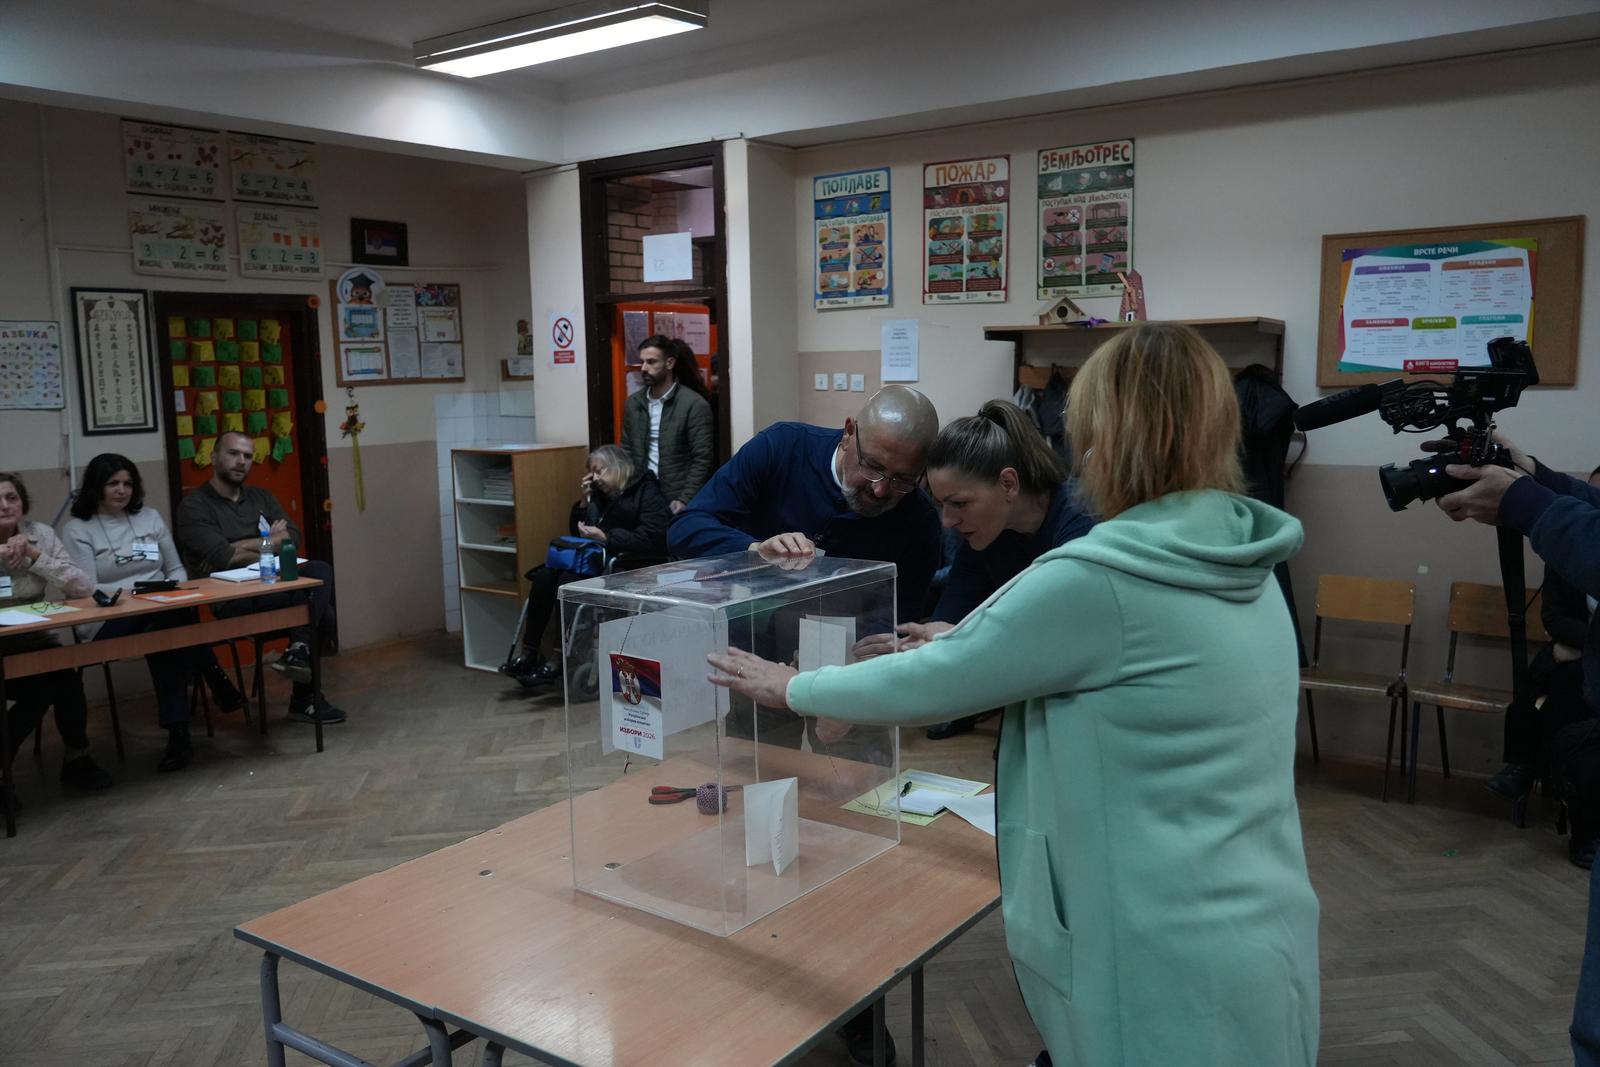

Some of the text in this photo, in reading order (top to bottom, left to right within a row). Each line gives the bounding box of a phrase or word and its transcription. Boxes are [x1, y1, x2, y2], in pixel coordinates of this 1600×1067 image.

[1042, 144, 1130, 171] ЗЕМЉОТРЕС
[936, 162, 996, 185] ПОЖАР
[823, 173, 880, 196] ПОПЛАВЕ
[1414, 246, 1458, 256] ВРСТЕ РЕЧИ
[2, 330, 48, 339] АЗБУКА
[620, 726, 656, 740] ИЗБОРИ 2026
